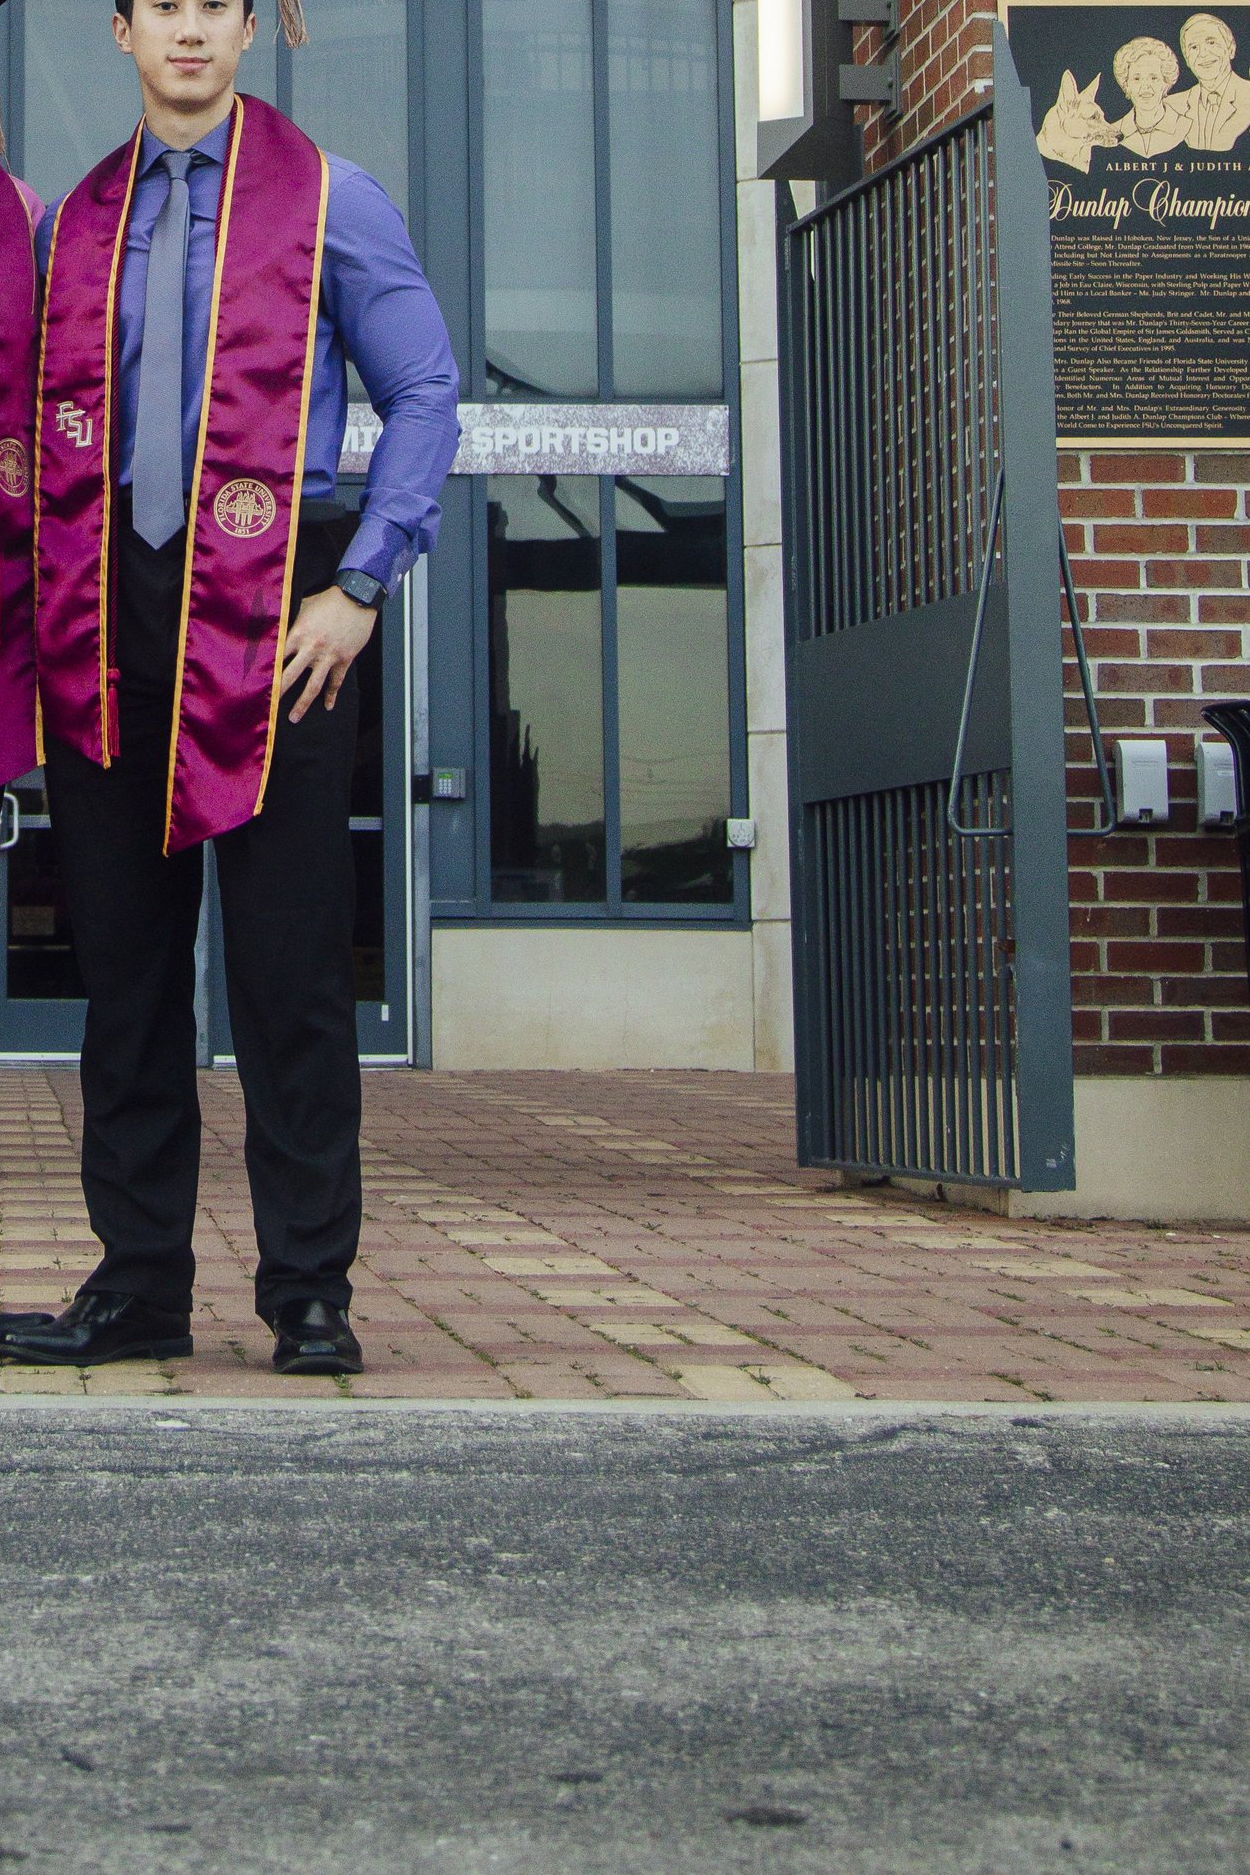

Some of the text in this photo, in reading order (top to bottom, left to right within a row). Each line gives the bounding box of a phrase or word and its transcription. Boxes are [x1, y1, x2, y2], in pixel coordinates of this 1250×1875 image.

[1106, 162, 1241, 173] ALBERT J & JUDITH
[1048, 179, 1132, 230] Dunlap
[1051, 235, 1075, 243] Dunlap
[1118, 244, 1141, 252] Dunlap
[1069, 273, 1086, 281] Early
[1135, 273, 1154, 281] Paper
[1156, 273, 1183, 281] Industry
[1200, 273, 1228, 281] Working
[1072, 320, 1096, 328] Journey
[1139, 320, 1167, 328] Dunlap's
[1170, 320, 1226, 328] Thirty-Seven-Year
[1089, 367, 1115, 375] Speaker.
[1145, 367, 1184, 375] Relationship
[1214, 367, 1248, 375] Developed
[1112, 414, 1131, 422] Judith
[1143, 414, 1166, 422] Dunlap
[1168, 414, 1205, 422] Champions
[55, 400, 93, 448] FSU
[471, 426, 680, 455] SPORTSHOP
[217, 481, 272, 527] FLORIDA STATE UNIVERSITY
